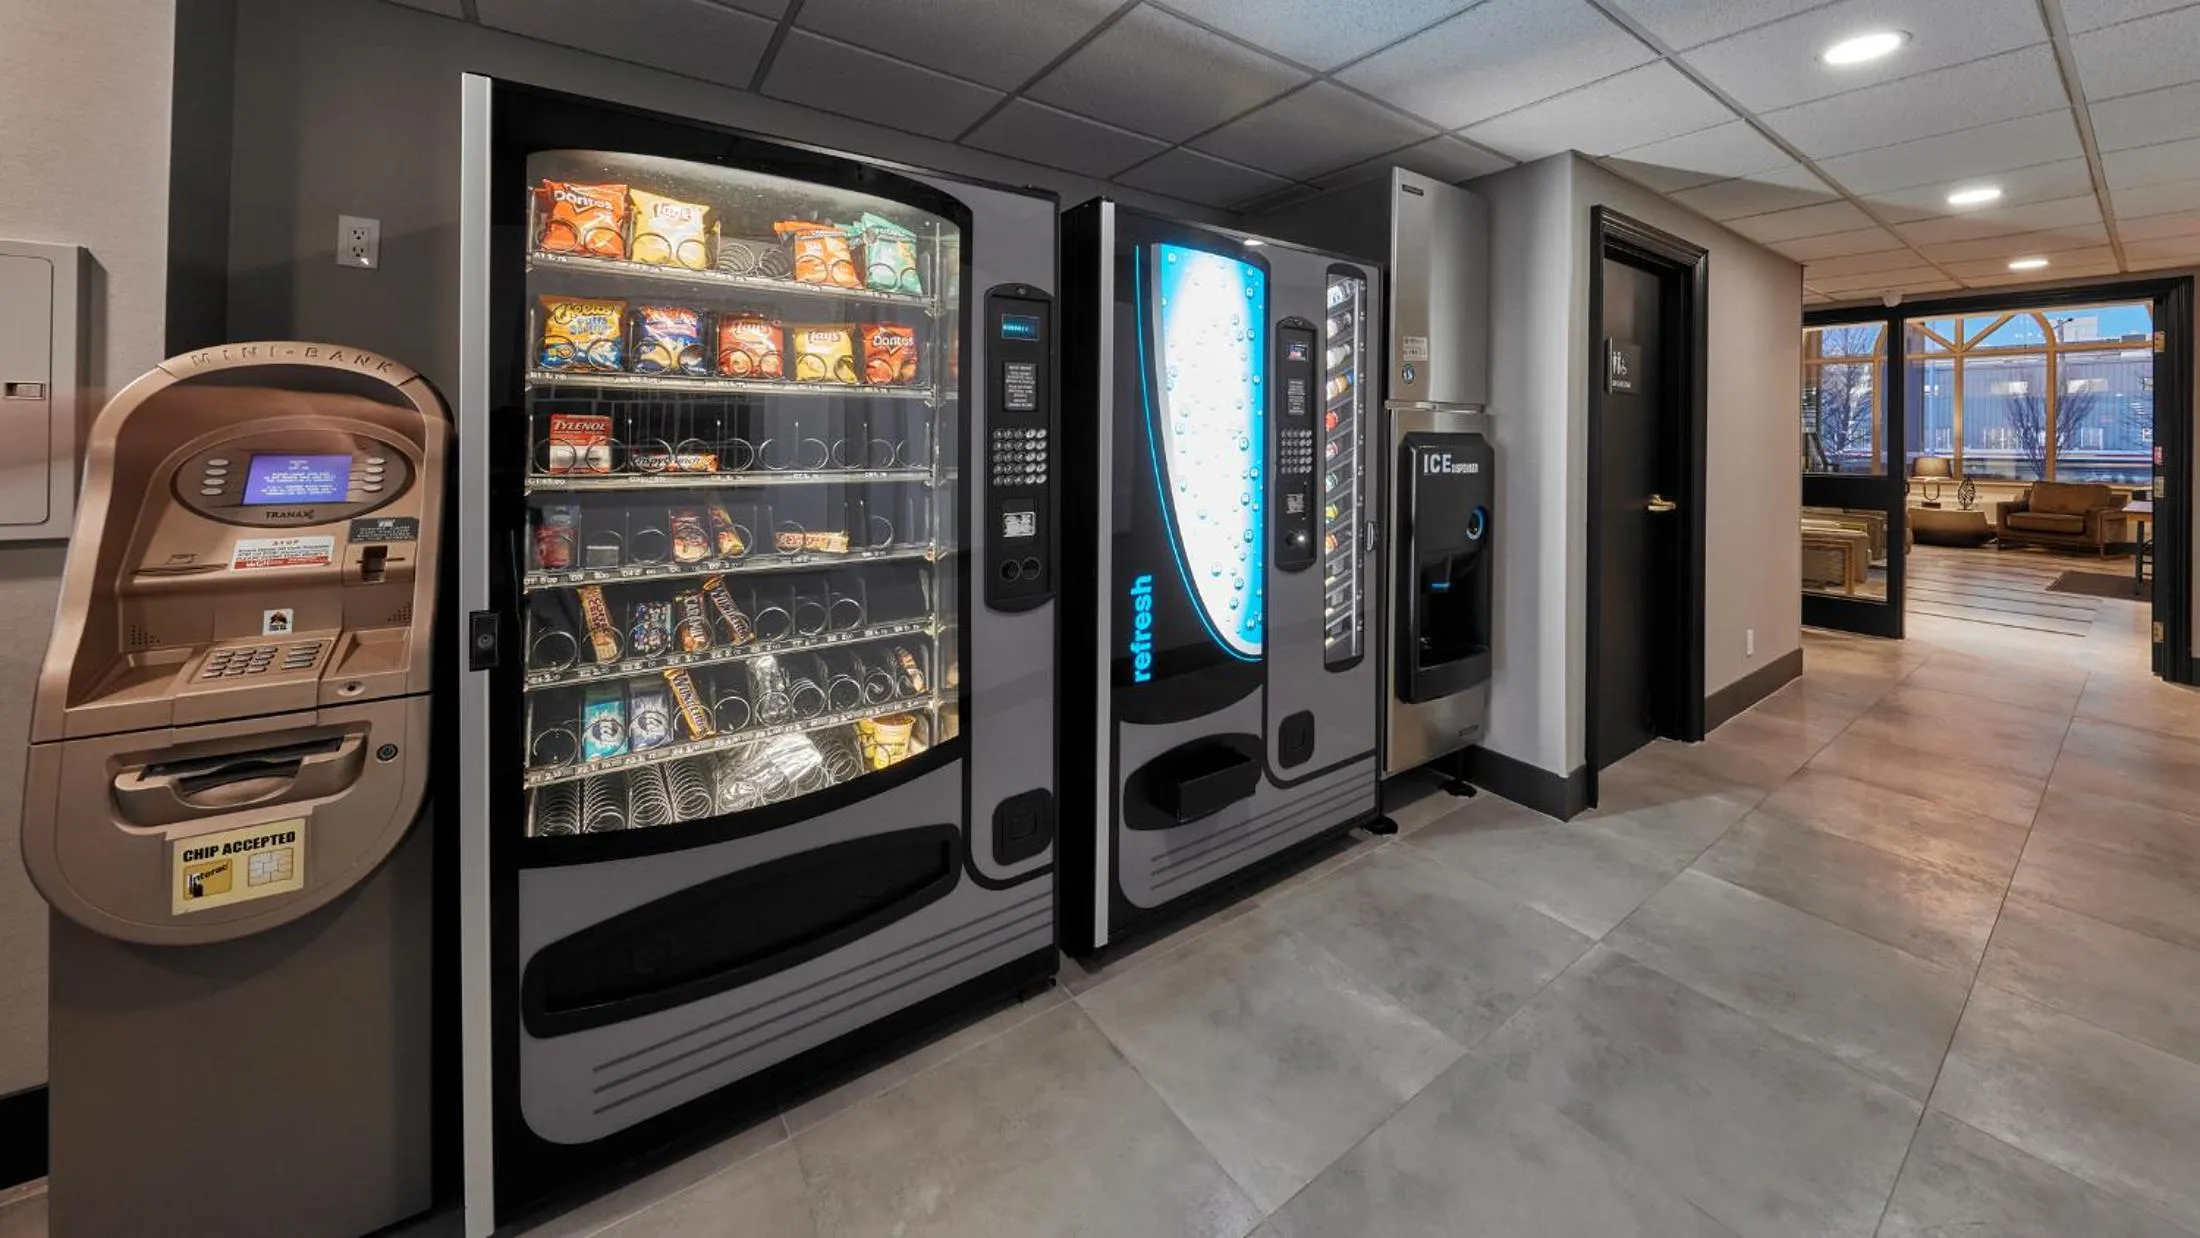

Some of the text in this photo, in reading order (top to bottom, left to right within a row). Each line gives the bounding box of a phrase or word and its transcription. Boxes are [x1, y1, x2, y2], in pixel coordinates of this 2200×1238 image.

[553, 190, 613, 210] Doritos
[873, 335, 915, 347] Doritos
[190, 345, 394, 374] MINI-BANK
[553, 420, 606, 431] TYLENOL
[1423, 453, 1452, 473] ICE
[266, 509, 314, 519] TRANAX
[1130, 574, 1152, 682] refresh
[183, 831, 296, 862] CHIP ACCEPTED
